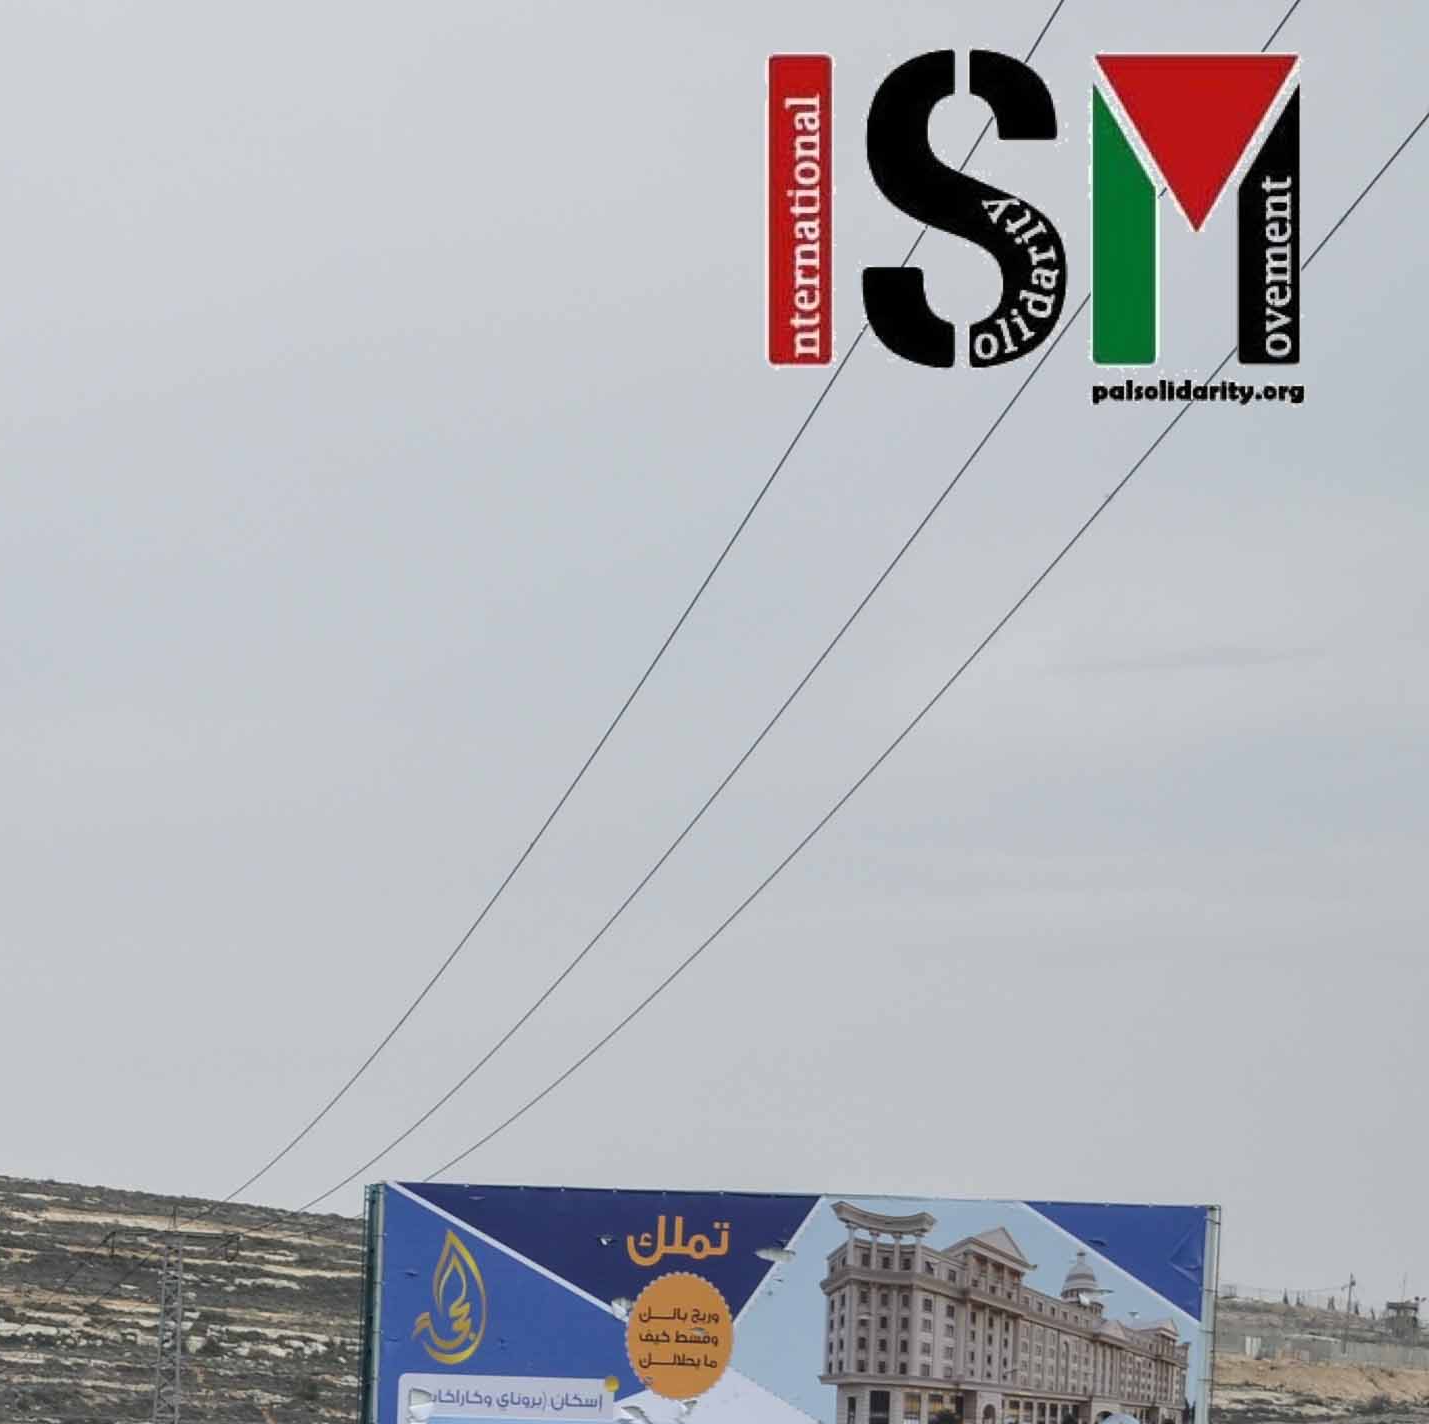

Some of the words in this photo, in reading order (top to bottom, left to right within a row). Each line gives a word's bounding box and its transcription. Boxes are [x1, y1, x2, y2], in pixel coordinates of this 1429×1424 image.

[626, 1215, 731, 1266] تملك
[639, 1329, 669, 1346] كيف
[704, 1354, 717, 1368] ما
